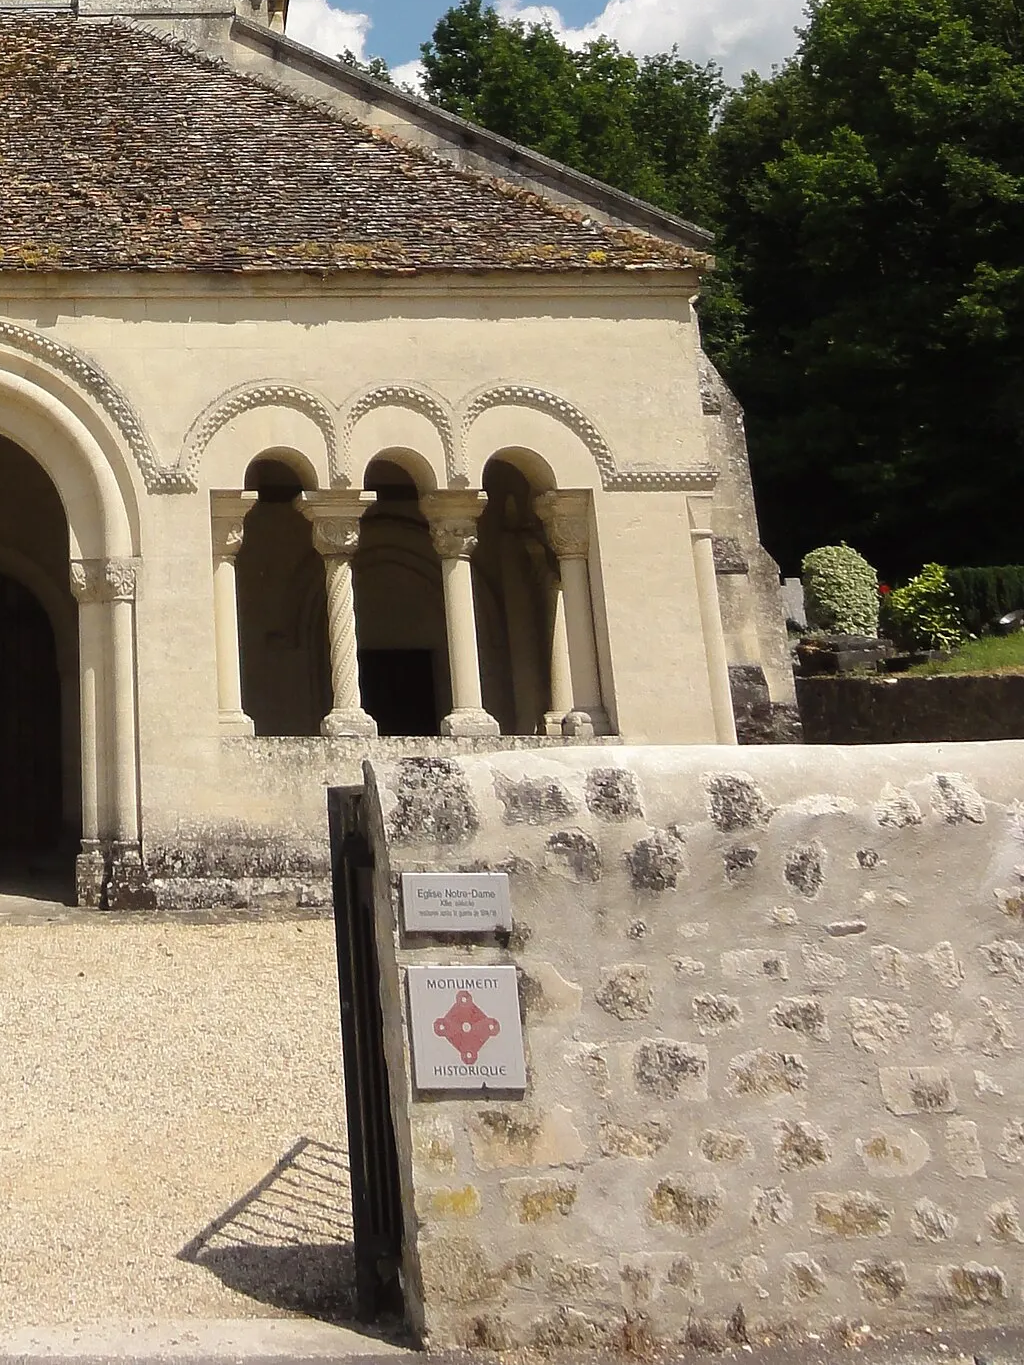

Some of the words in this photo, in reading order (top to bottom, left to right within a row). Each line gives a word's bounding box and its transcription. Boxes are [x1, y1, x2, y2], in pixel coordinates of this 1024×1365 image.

[417, 888, 442, 899] Eglise
[445, 888, 496, 898] Notre-Dame
[426, 979, 499, 989] MONUMENT
[433, 1065, 507, 1076] HISTORIQUE
